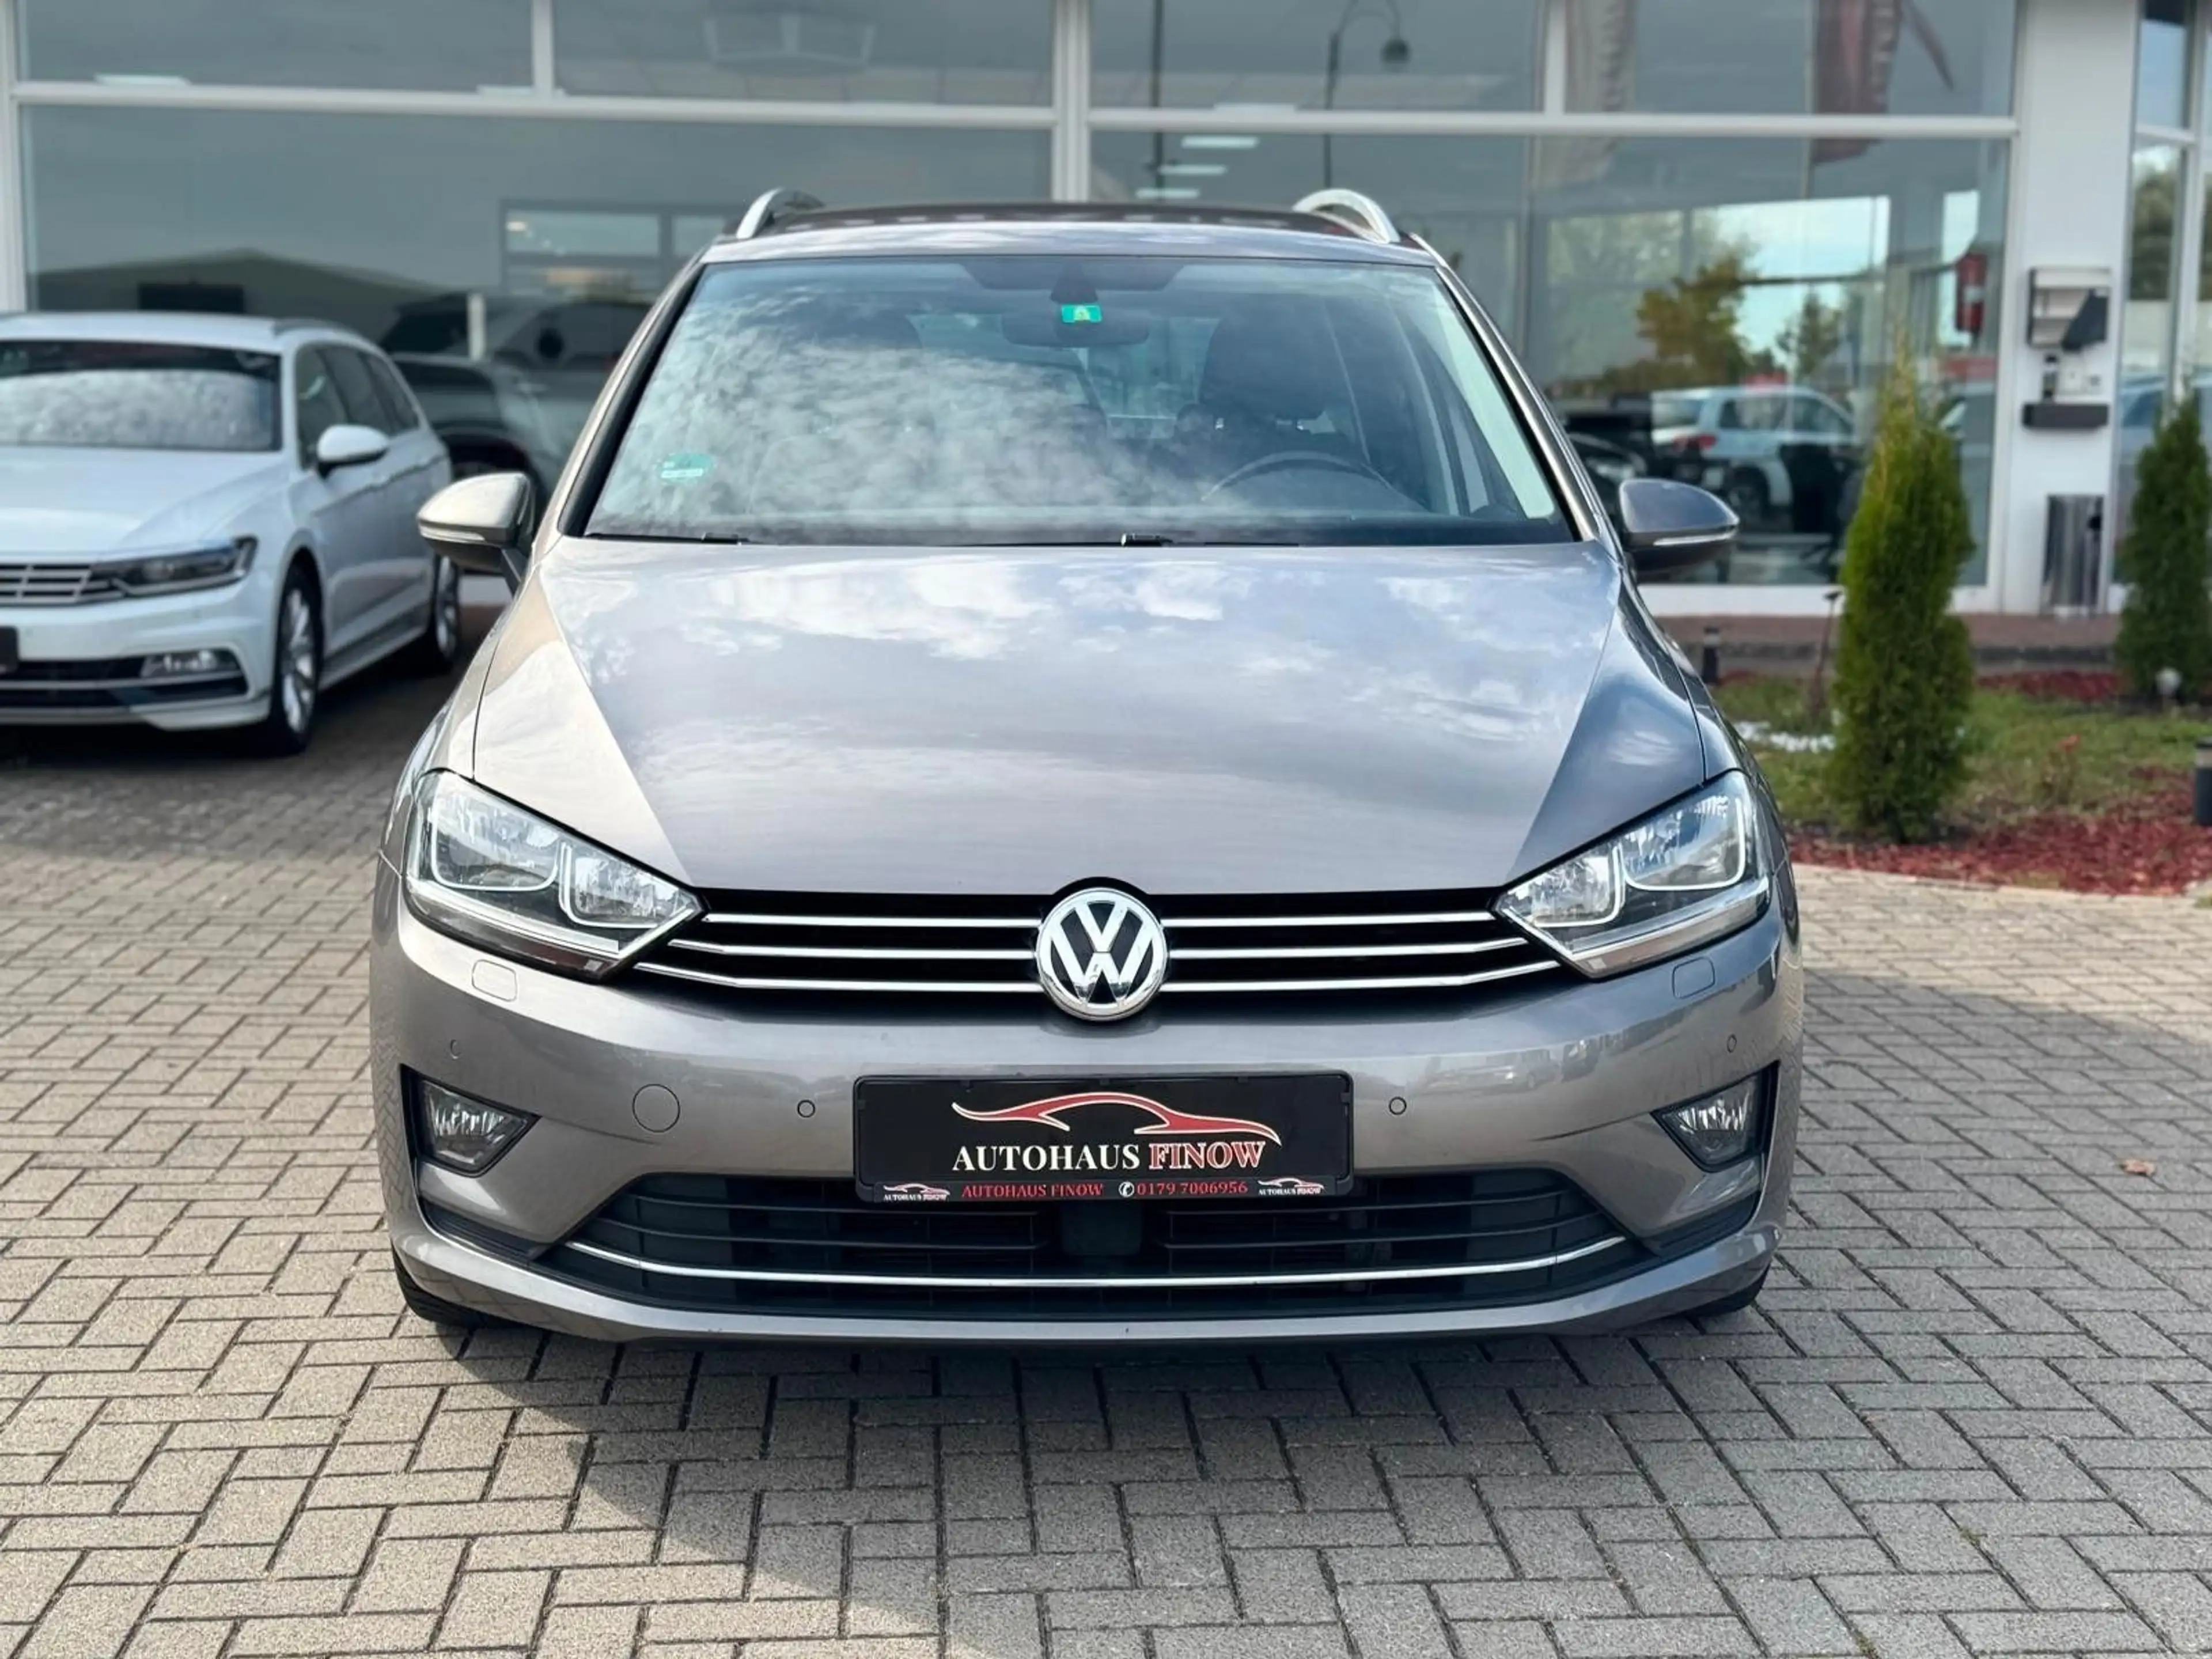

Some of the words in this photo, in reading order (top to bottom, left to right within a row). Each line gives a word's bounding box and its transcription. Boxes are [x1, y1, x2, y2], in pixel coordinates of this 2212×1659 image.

[1035, 887, 1168, 1021] VW
[952, 1144, 1141, 1172] AUTOHAUS
[1149, 1140, 1267, 1170] FINOW
[961, 1184, 1047, 1199] AUTOHAUS
[1051, 1183, 1105, 1197] FINOW
[1137, 1183, 1176, 1196] 0179
[1181, 1181, 1249, 1195] 7006956
